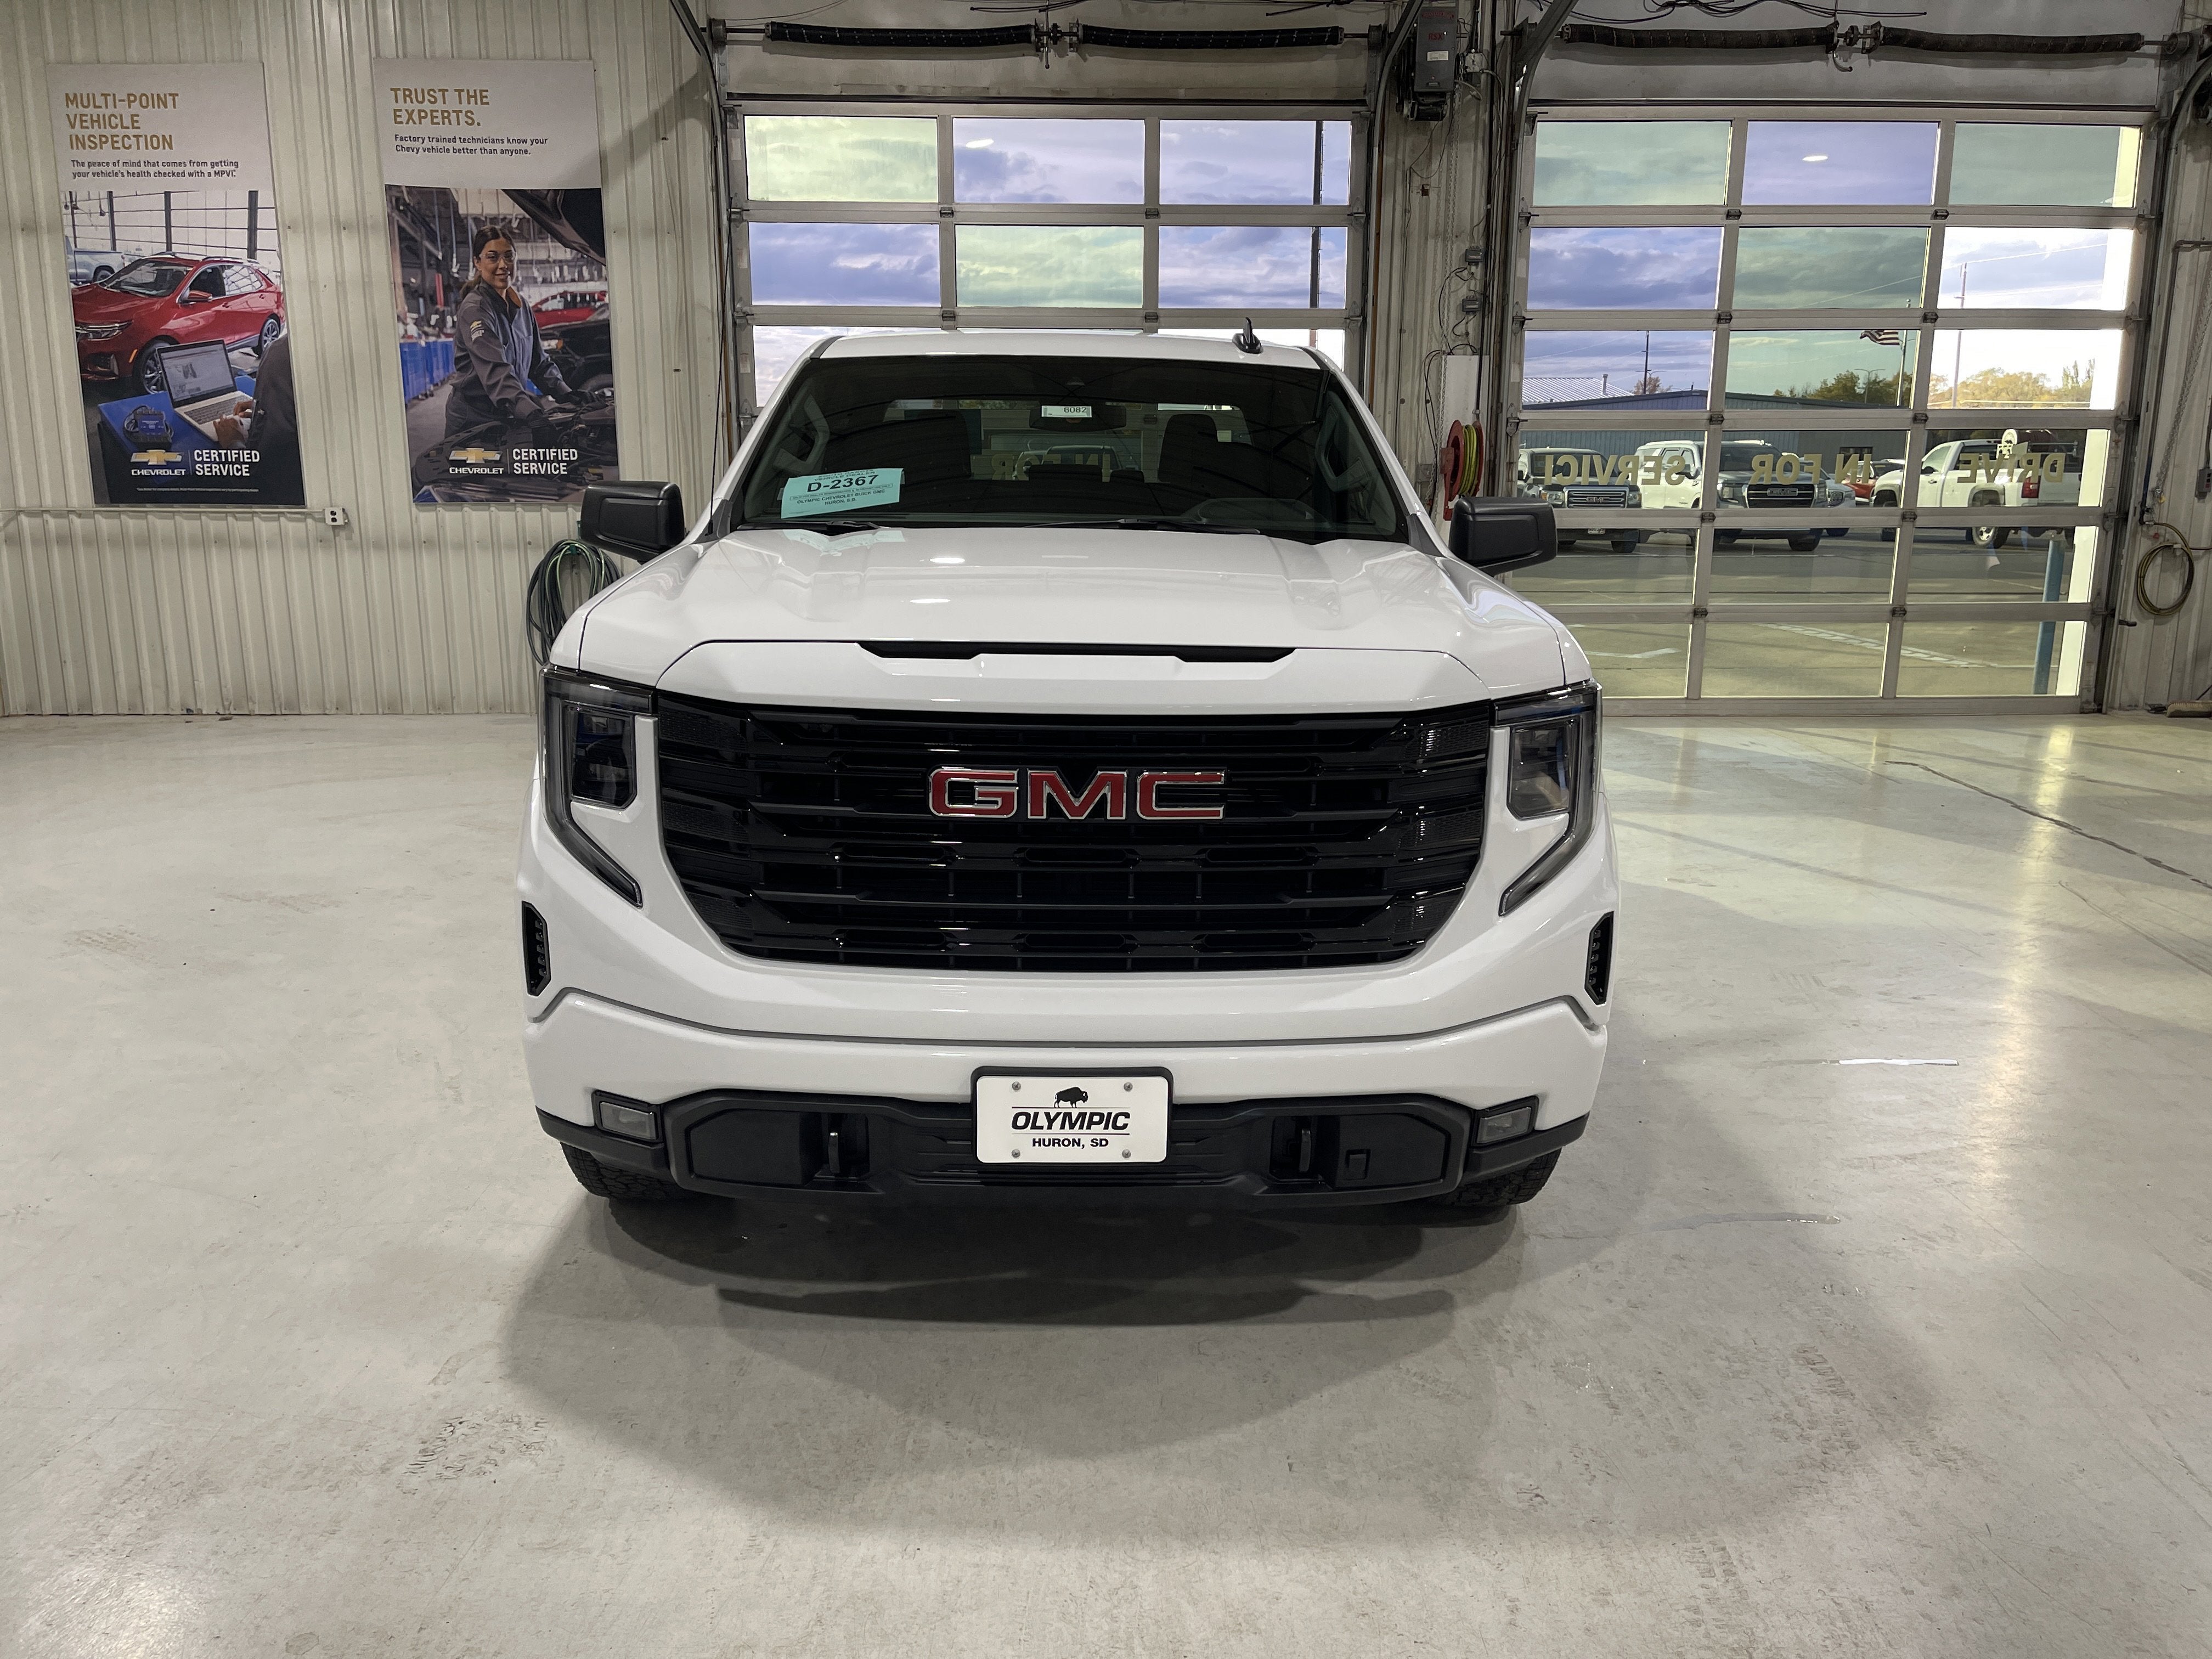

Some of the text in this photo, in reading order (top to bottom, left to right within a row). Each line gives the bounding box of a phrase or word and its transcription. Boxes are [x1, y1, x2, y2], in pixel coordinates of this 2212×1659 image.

[65, 93, 179, 109] MULTI-POINT
[390, 88, 490, 105] TRUST THE
[66, 114, 140, 129] VEHICLE
[393, 109, 481, 126] EXPERTS.
[69, 134, 173, 150] INSPECTION
[394, 134, 426, 144] Factory
[396, 144, 420, 154] Chevy
[210, 159, 239, 168] getting
[194, 449, 260, 463] CERTIFIED
[512, 448, 578, 461] CERTIFIED
[195, 464, 250, 476] SERVICE
[513, 462, 568, 475] SERVICE
[807, 475, 879, 492] D-2367
[929, 768, 1225, 820] GMC
[1012, 1111, 1130, 1130] OLYMPIC
[1032, 1138, 1109, 1149] HURON, SD
